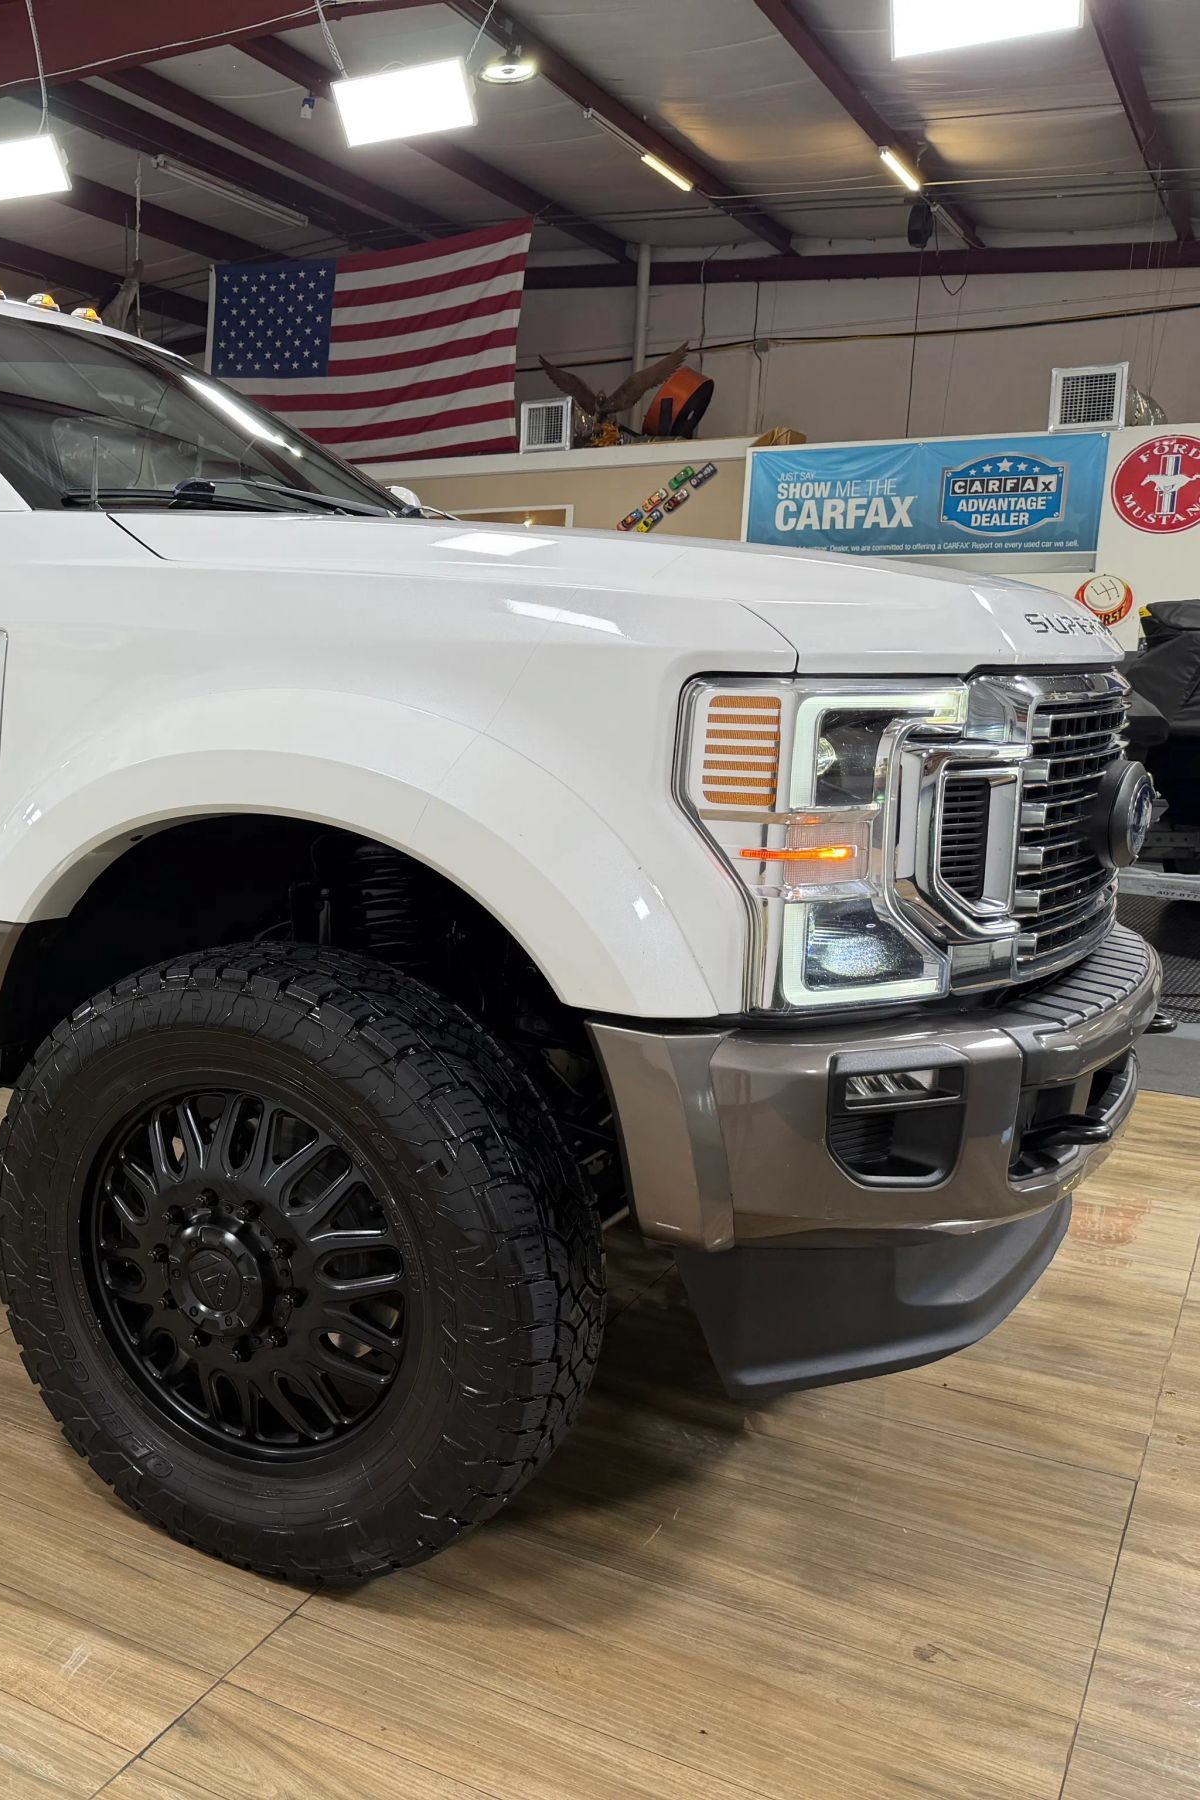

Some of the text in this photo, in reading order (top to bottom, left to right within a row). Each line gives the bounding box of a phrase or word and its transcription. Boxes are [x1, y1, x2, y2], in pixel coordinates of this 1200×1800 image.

[1139, 443, 1200, 463] FORD
[777, 471, 816, 482] JUST SAY
[777, 478, 897, 500] SHOW ME THE
[953, 478, 1053, 494] CARFAX
[774, 495, 915, 532] CARFAX
[956, 496, 1047, 513] ADVANTAGE
[1122, 492, 1200, 525] MUSTAN
[970, 512, 1030, 527] DEALER
[872, 543, 904, 552] committed
[912, 542, 936, 552] offering
[972, 541, 993, 550] Report
[1004, 542, 1022, 550] every
[1023, 540, 1040, 548] used
[83, 1388, 175, 1479] OPEN
